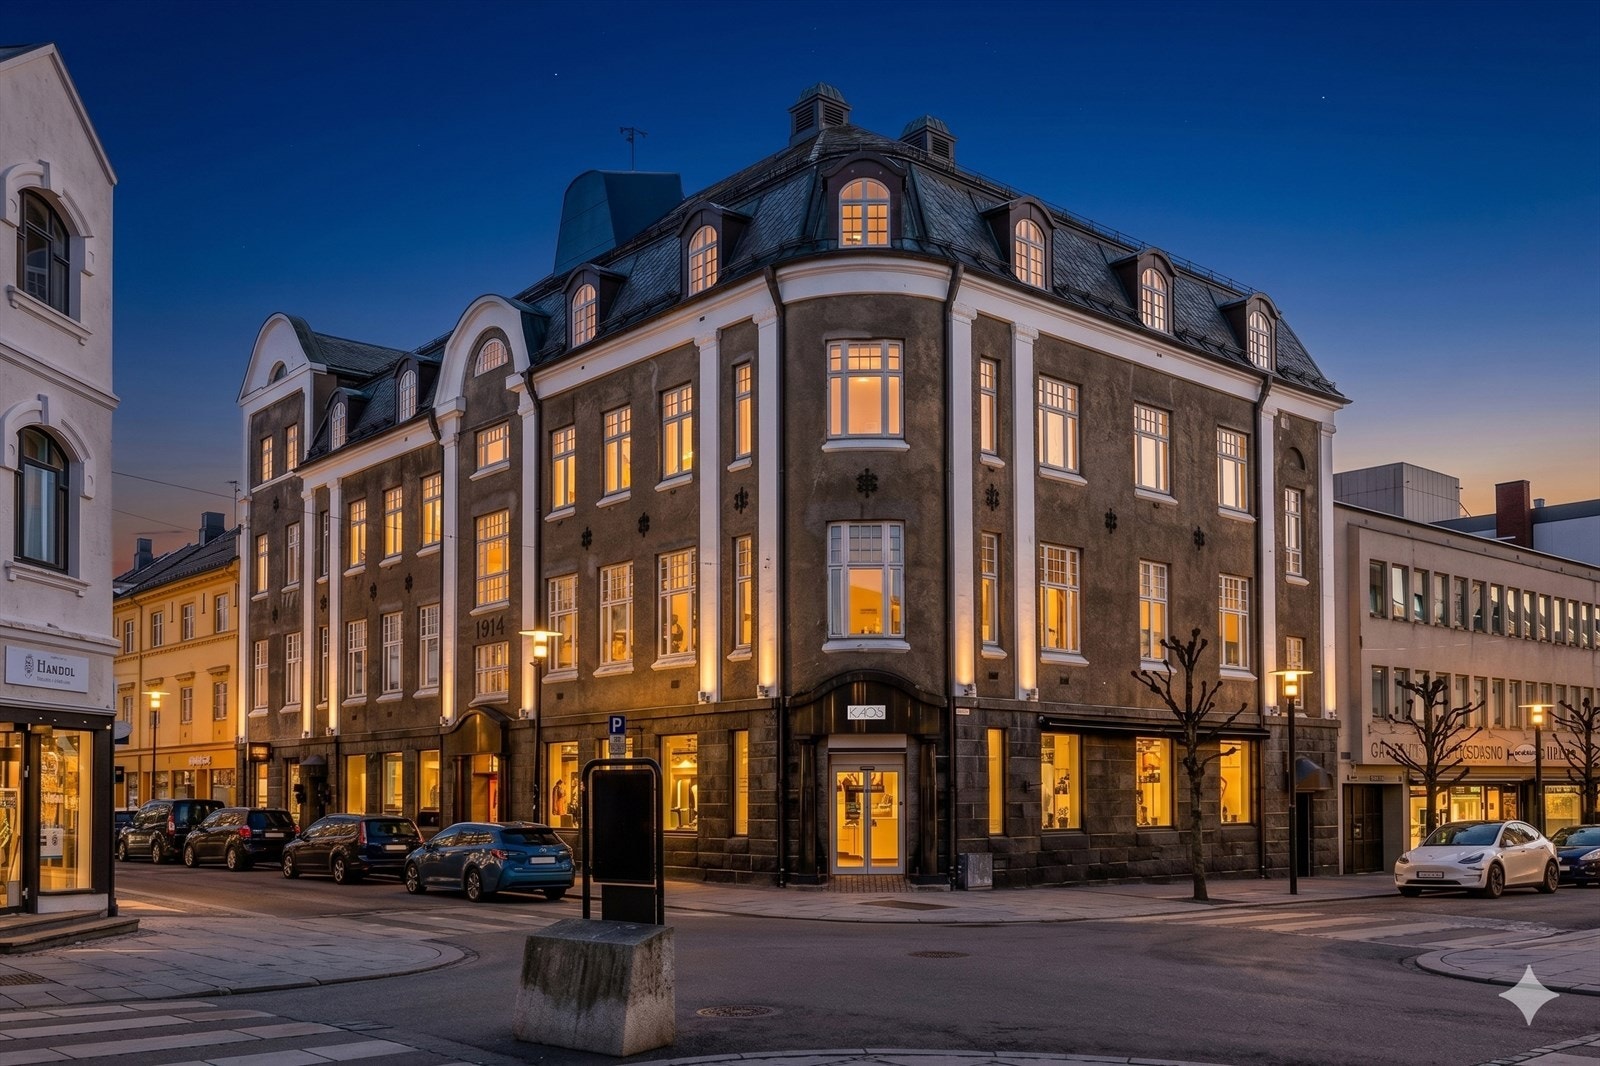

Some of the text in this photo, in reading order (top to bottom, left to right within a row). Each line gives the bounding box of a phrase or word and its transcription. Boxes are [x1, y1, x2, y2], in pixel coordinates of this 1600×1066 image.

[476, 615, 505, 640] 1914
[850, 707, 884, 718] KAOS
[612, 717, 622, 733] P
